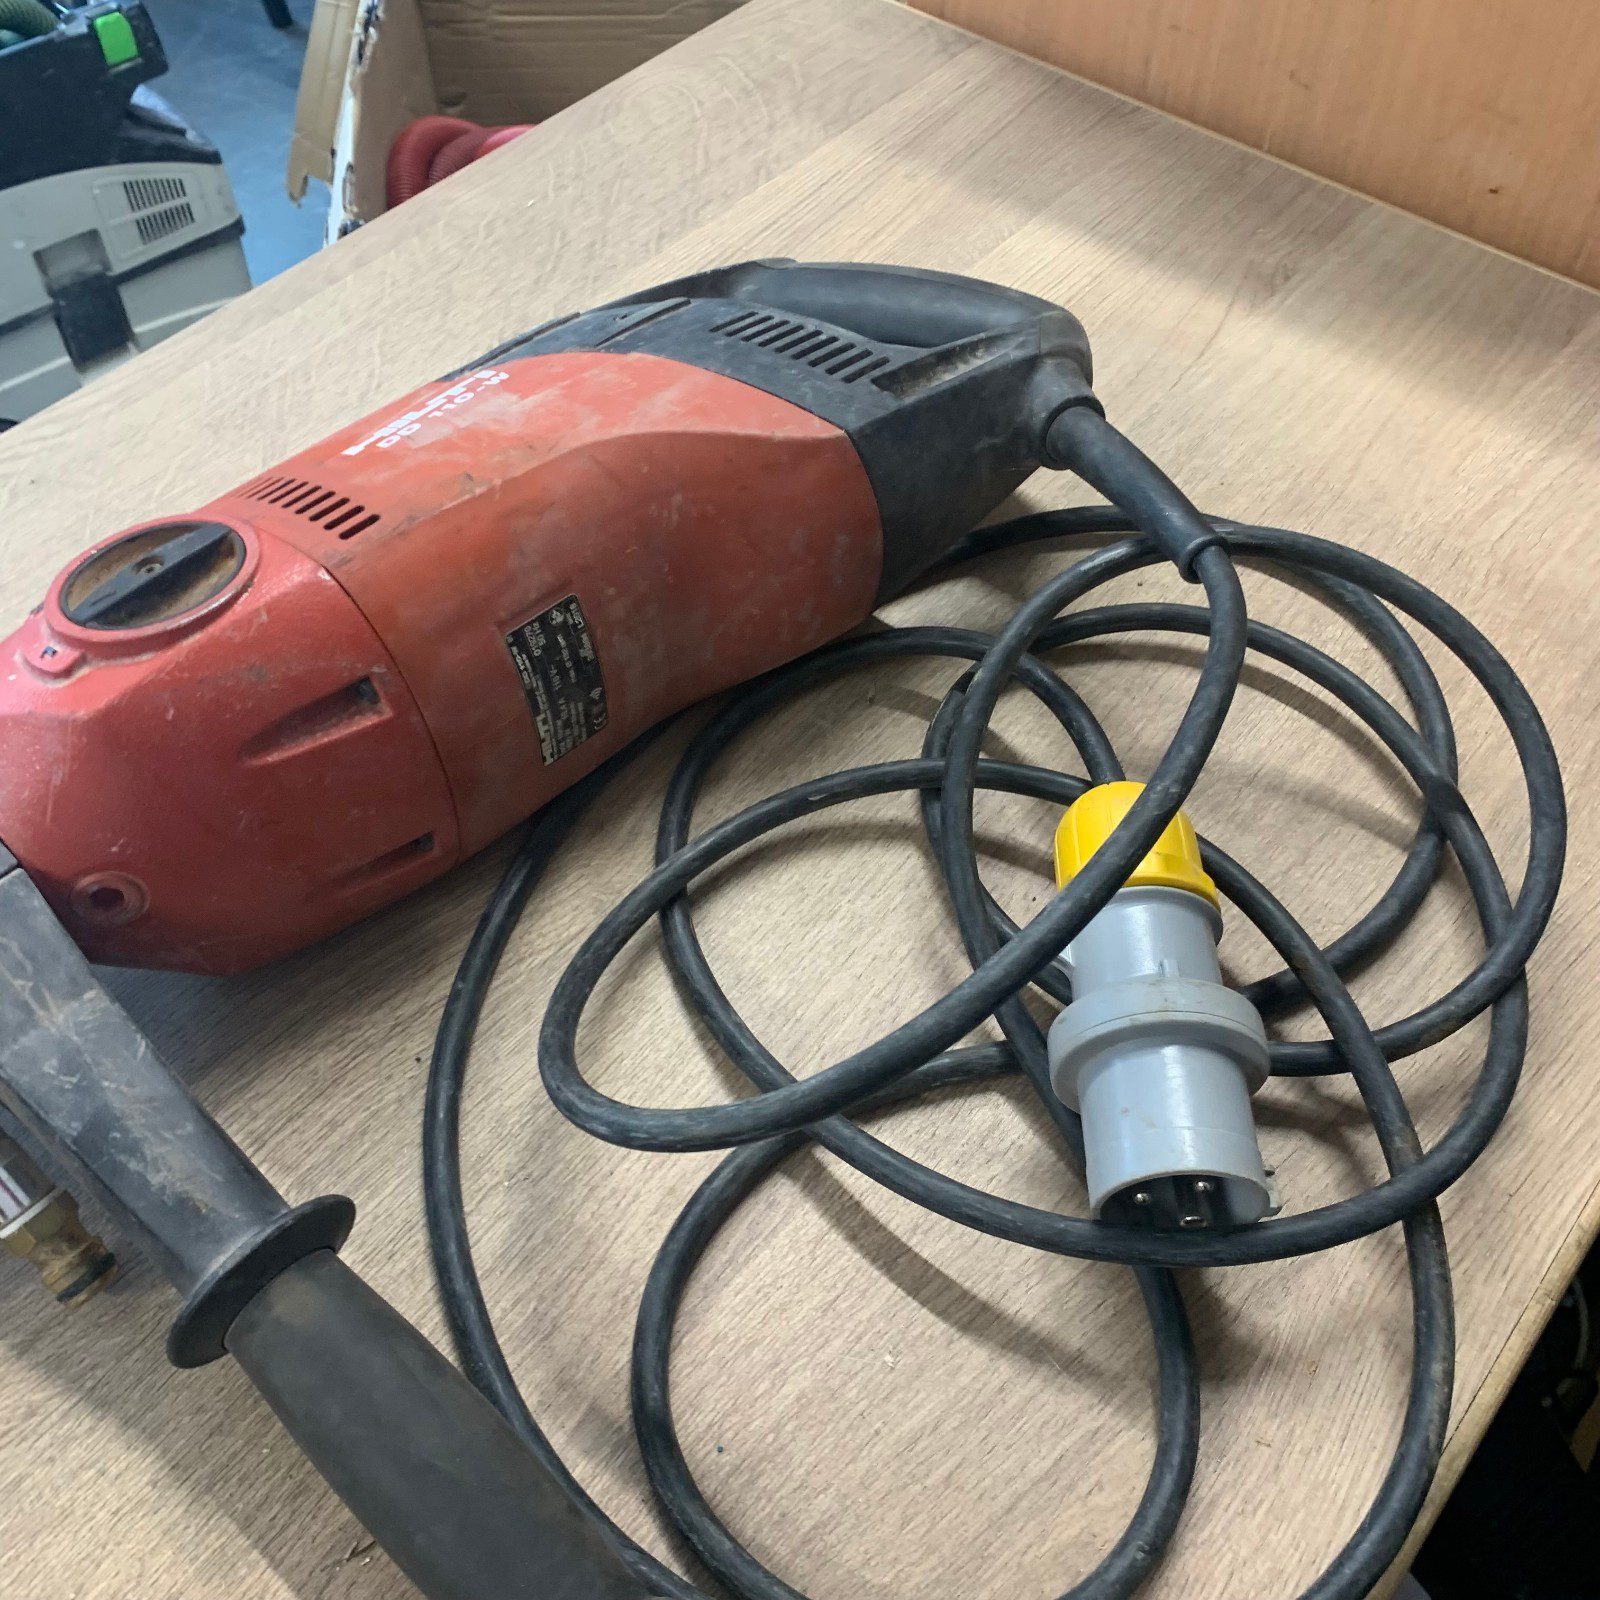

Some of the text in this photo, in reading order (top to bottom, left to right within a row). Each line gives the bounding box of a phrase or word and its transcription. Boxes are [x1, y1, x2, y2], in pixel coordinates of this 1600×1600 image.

[341, 369, 497, 456] HILTI
[376, 371, 510, 449] DD 110-W
